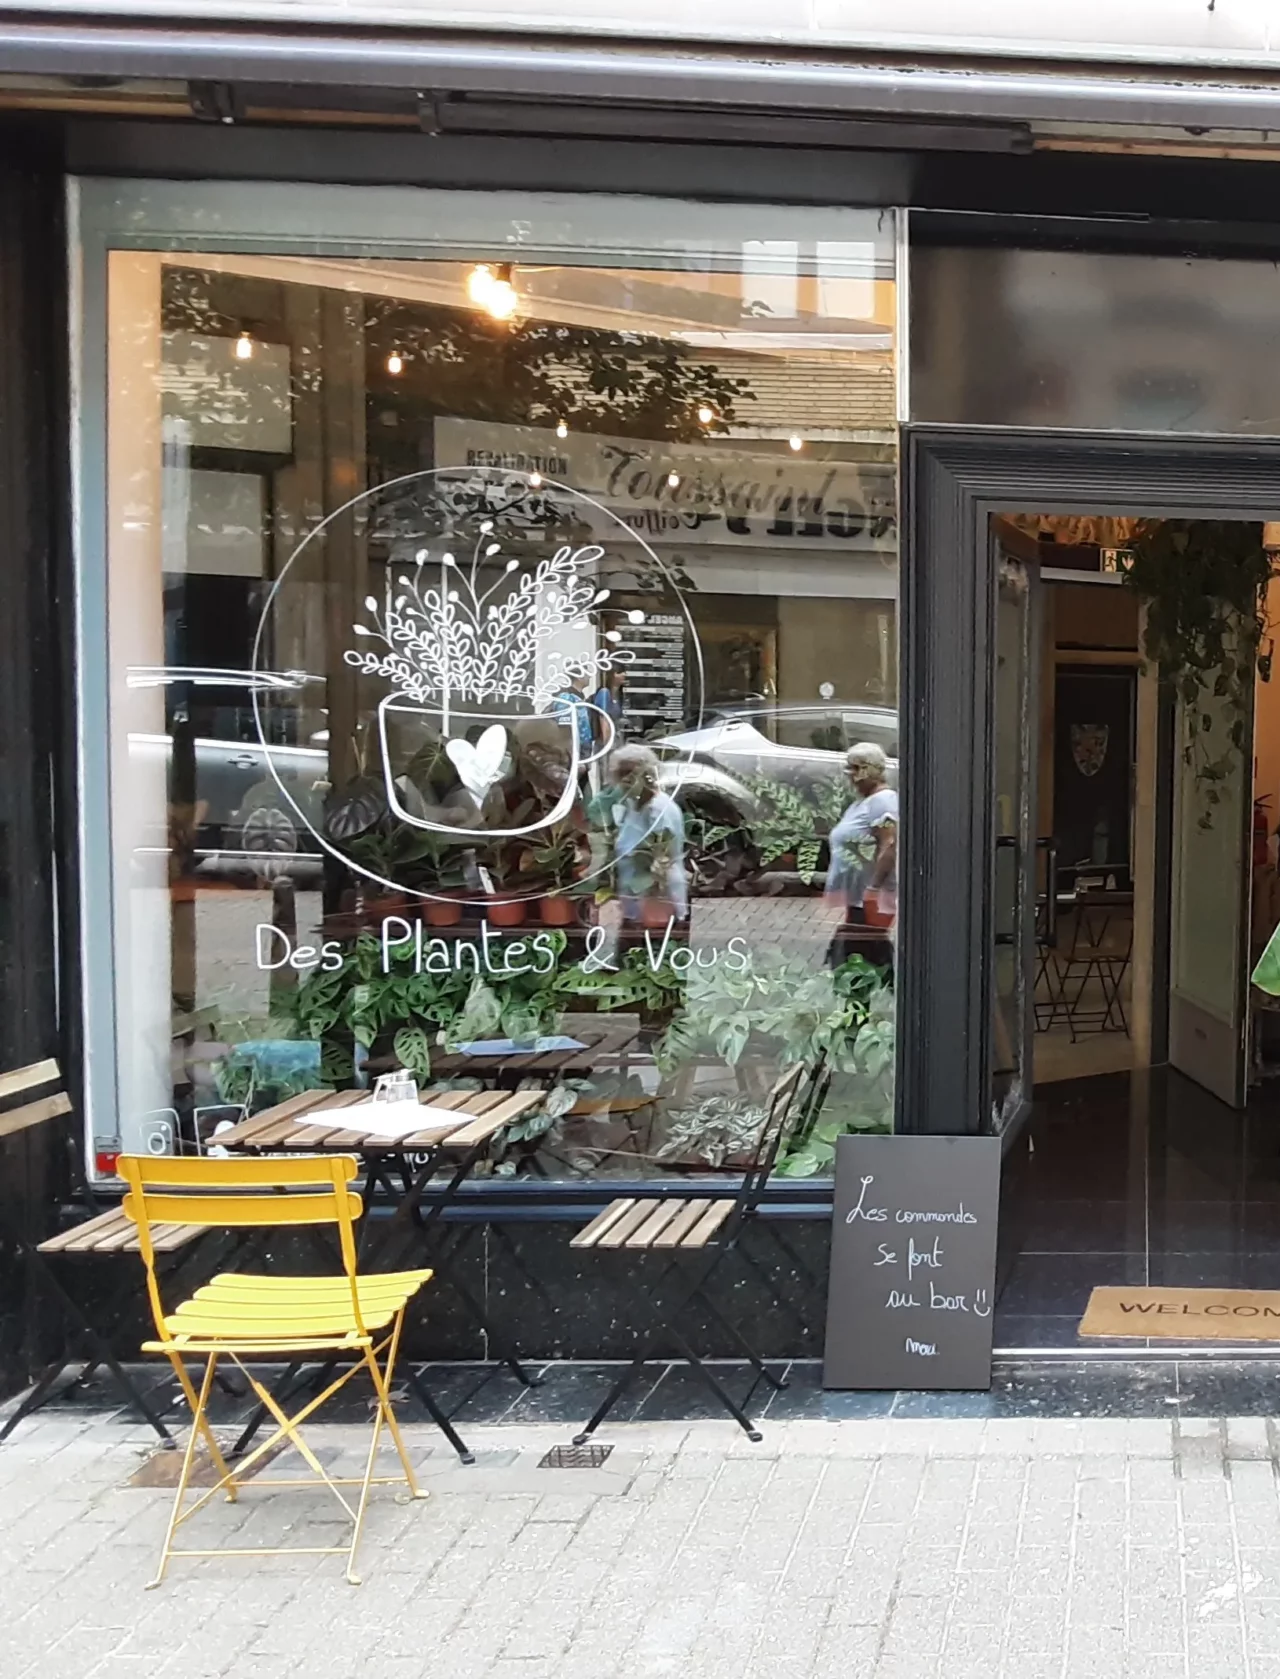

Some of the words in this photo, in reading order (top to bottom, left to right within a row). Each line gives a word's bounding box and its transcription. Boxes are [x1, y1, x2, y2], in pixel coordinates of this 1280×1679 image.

[255, 923, 344, 971] Des
[381, 915, 555, 974] Plantes
[582, 925, 620, 974] &
[644, 914, 748, 971] Vous
[845, 1174, 889, 1224] Les
[894, 1202, 978, 1225] commandes
[885, 1288, 921, 1309] au
